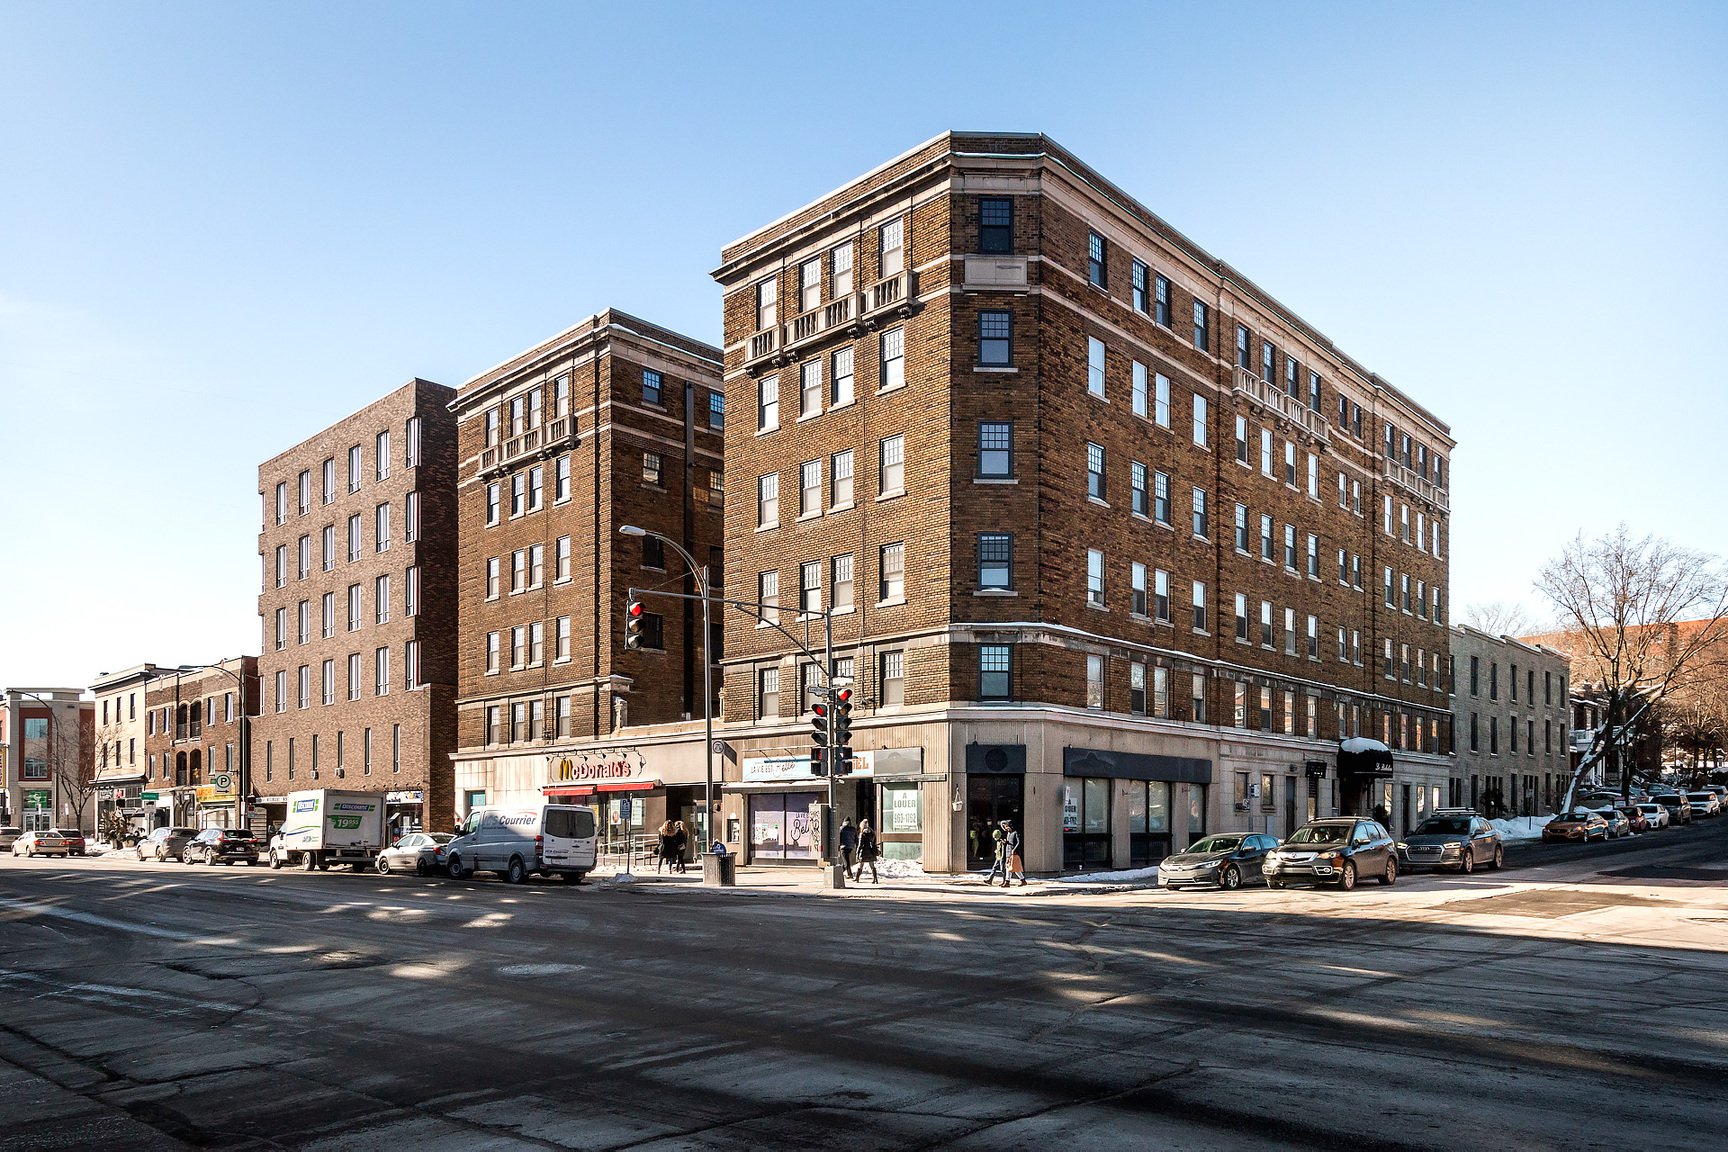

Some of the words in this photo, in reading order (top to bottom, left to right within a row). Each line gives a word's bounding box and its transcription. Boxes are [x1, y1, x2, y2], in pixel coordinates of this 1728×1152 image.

[559, 758, 631, 781] McDonald's
[220, 777, 228, 785] P
[893, 800, 917, 808] LOUER
[1064, 805, 1077, 813] OUER
[499, 812, 537, 826] Courrier
